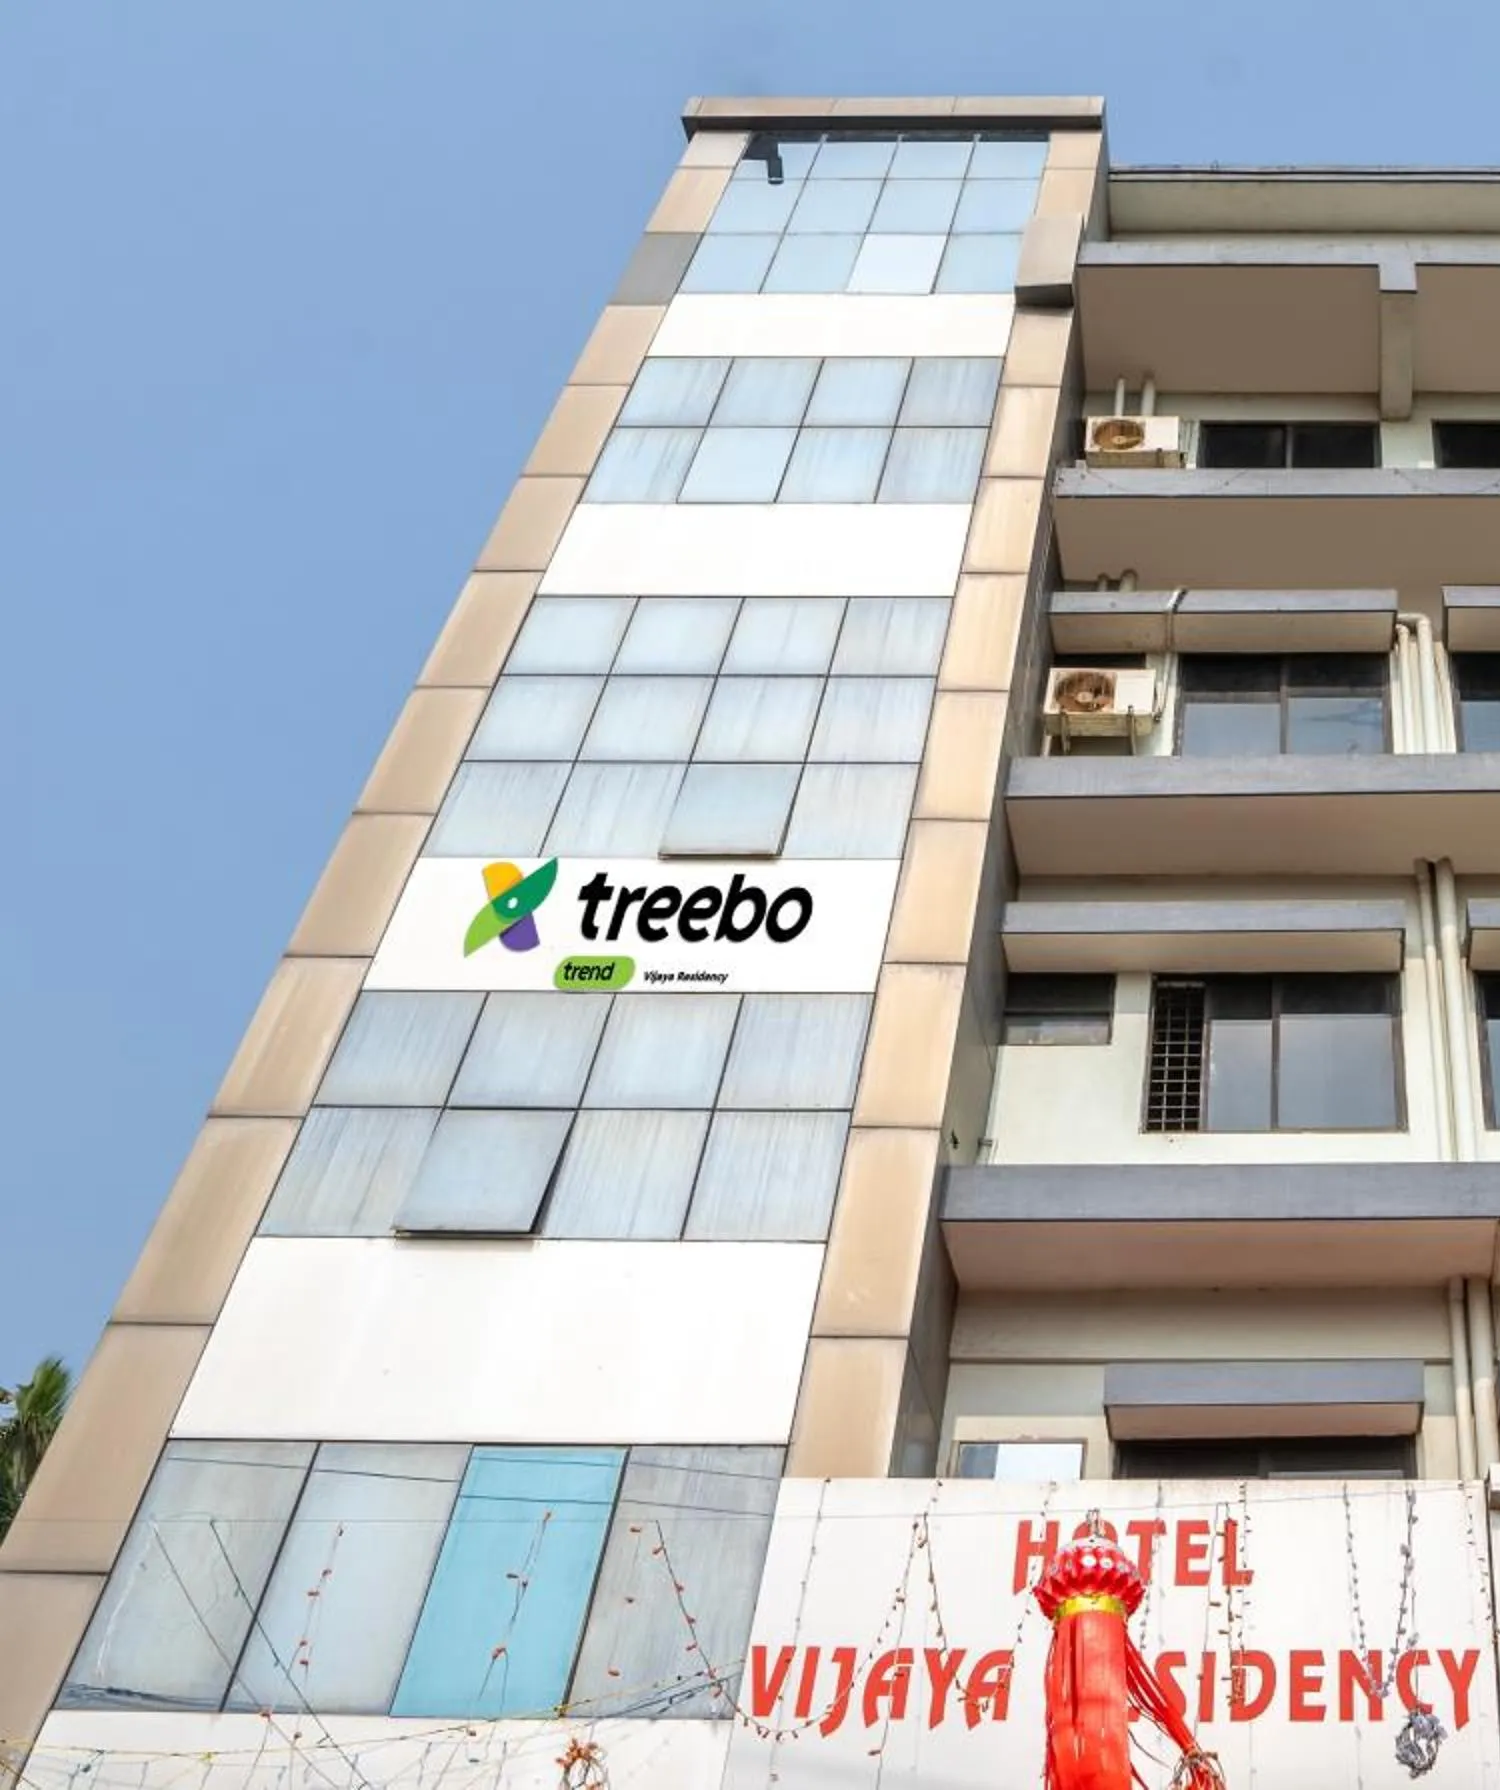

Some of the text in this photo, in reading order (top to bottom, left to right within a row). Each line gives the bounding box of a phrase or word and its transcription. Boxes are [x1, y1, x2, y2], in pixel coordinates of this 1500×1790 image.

[578, 872, 814, 944] treebo
[562, 961, 616, 982] trend
[643, 970, 729, 985] Vijaya Residency
[1011, 1515, 1255, 1595] HTEL
[750, 1644, 1015, 1738] VIJAYA
